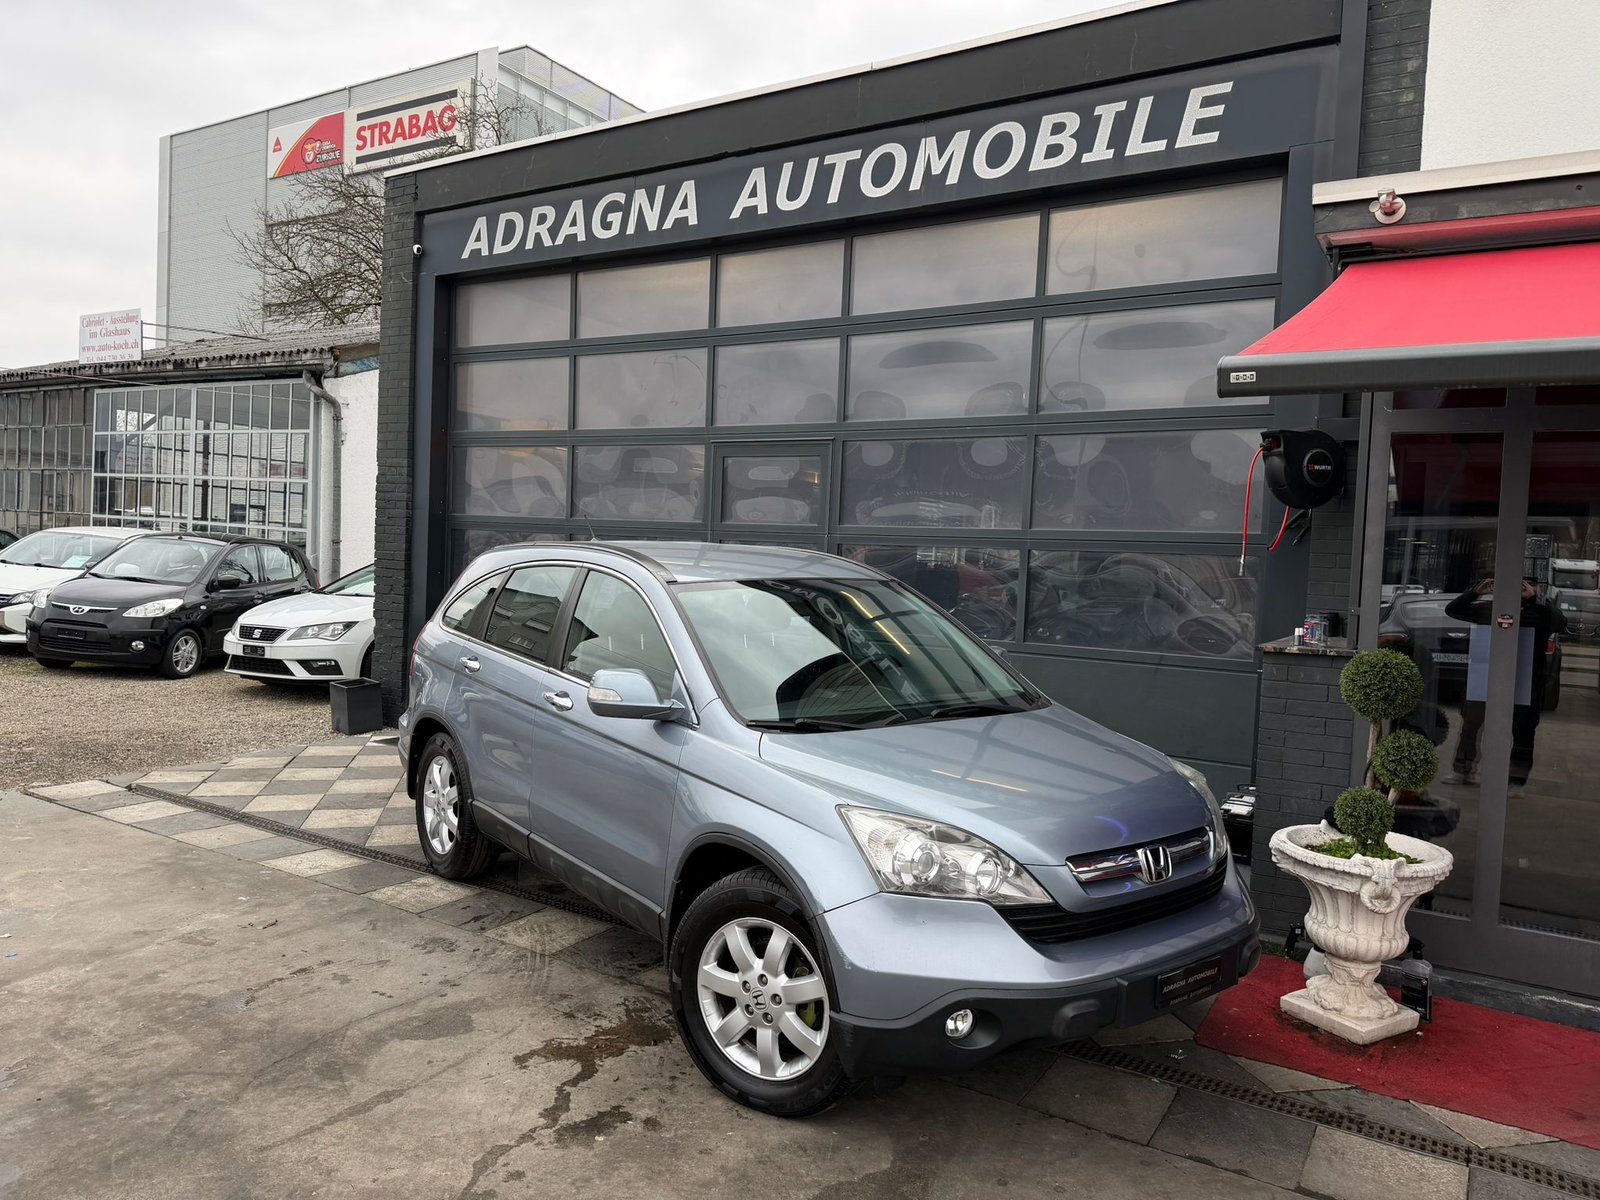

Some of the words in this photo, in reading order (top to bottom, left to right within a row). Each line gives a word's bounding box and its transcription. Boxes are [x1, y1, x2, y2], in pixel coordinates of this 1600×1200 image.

[355, 104, 456, 151] STRABAG
[461, 179, 699, 260] ADRAGNA
[730, 81, 1235, 220] AUTOMOBILE
[81, 339, 139, 353] www.auto-koch.ch
[89, 329, 97, 339] im
[100, 327, 131, 338] Glashaus
[1162, 979, 1186, 993] ADRAGNA
[1187, 967, 1218, 983] AUTOMOBILE
